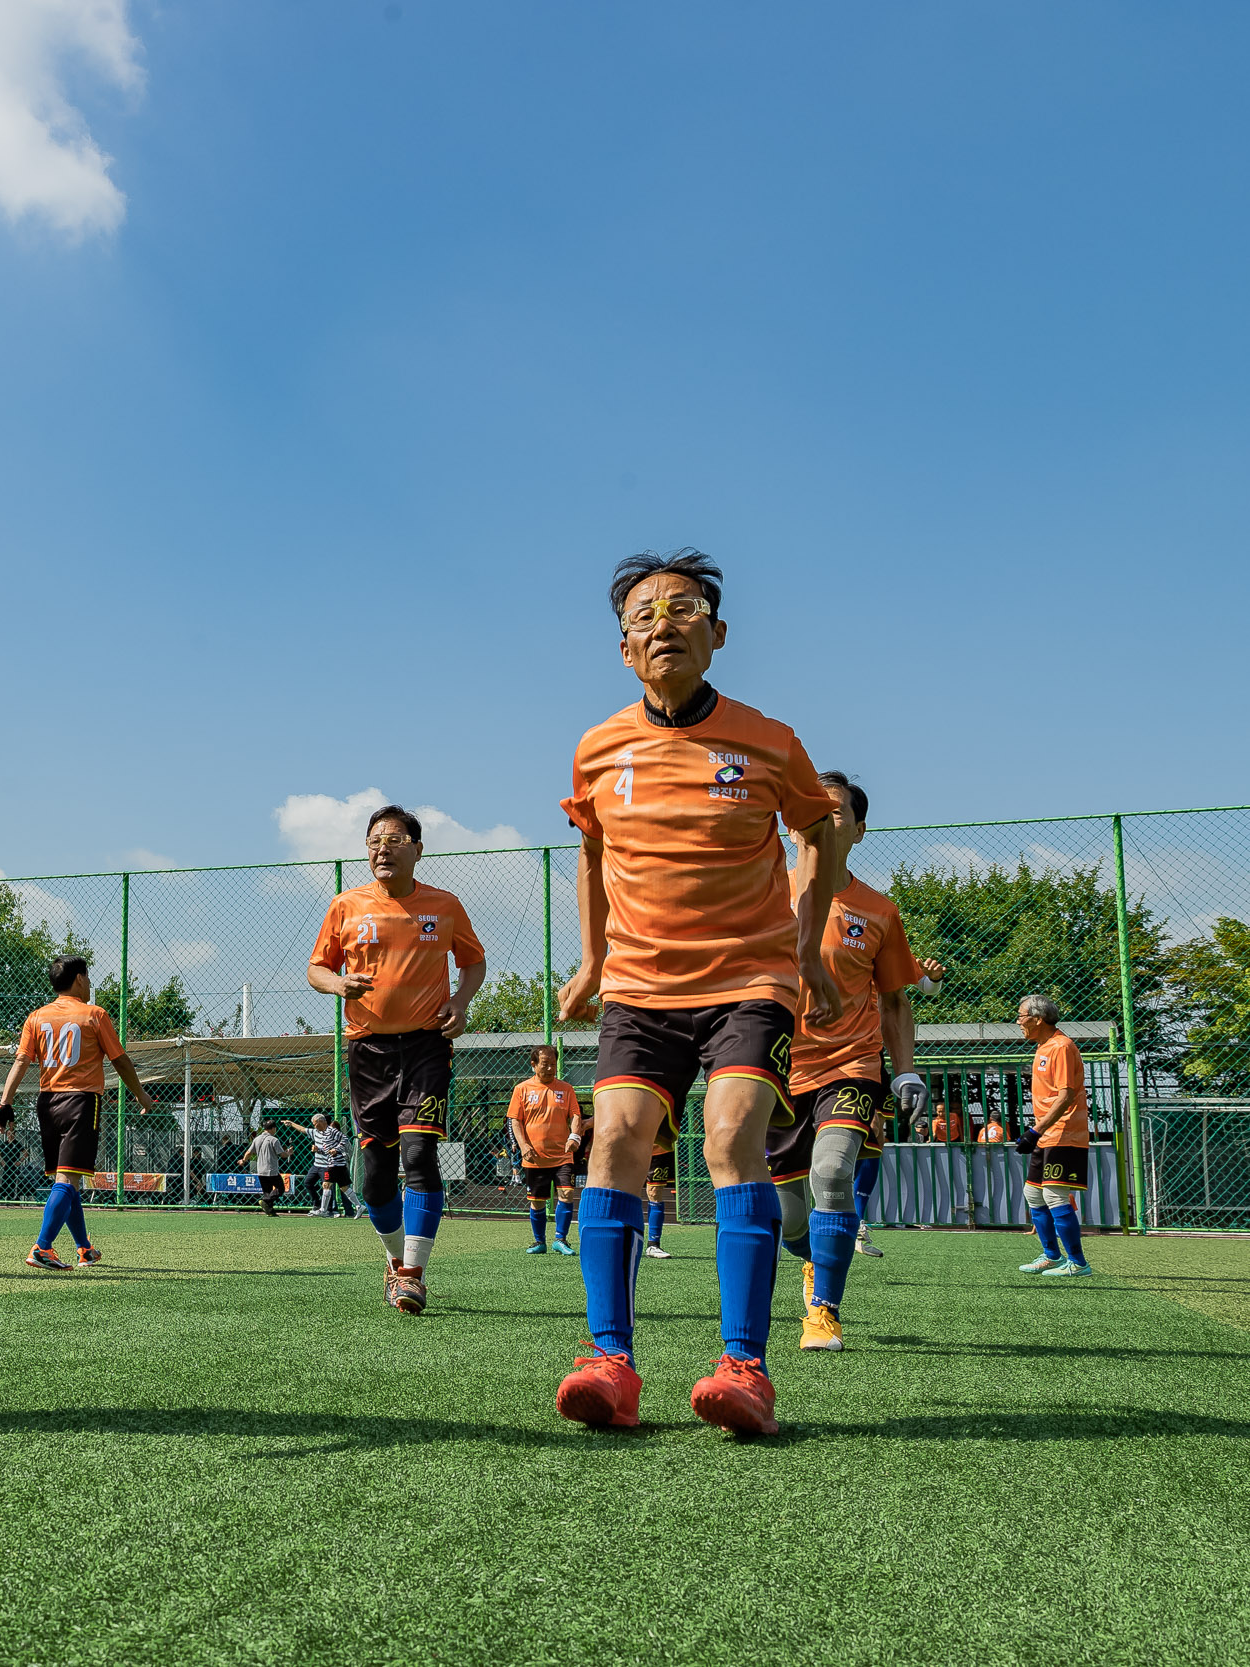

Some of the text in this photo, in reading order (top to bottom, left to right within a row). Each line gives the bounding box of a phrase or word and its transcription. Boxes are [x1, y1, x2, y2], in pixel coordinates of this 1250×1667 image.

[708, 751, 751, 766] SEOUL
[613, 767, 635, 806] 4
[708, 786, 748, 801] 광진70
[418, 914, 439, 922] SEOUL
[844, 912, 868, 928] SEOUL
[357, 922, 380, 944] 21
[40, 1021, 82, 1068] 10
[417, 1095, 447, 1124] 21
[831, 1086, 873, 1122] 29
[1043, 1163, 1064, 1179] 30
